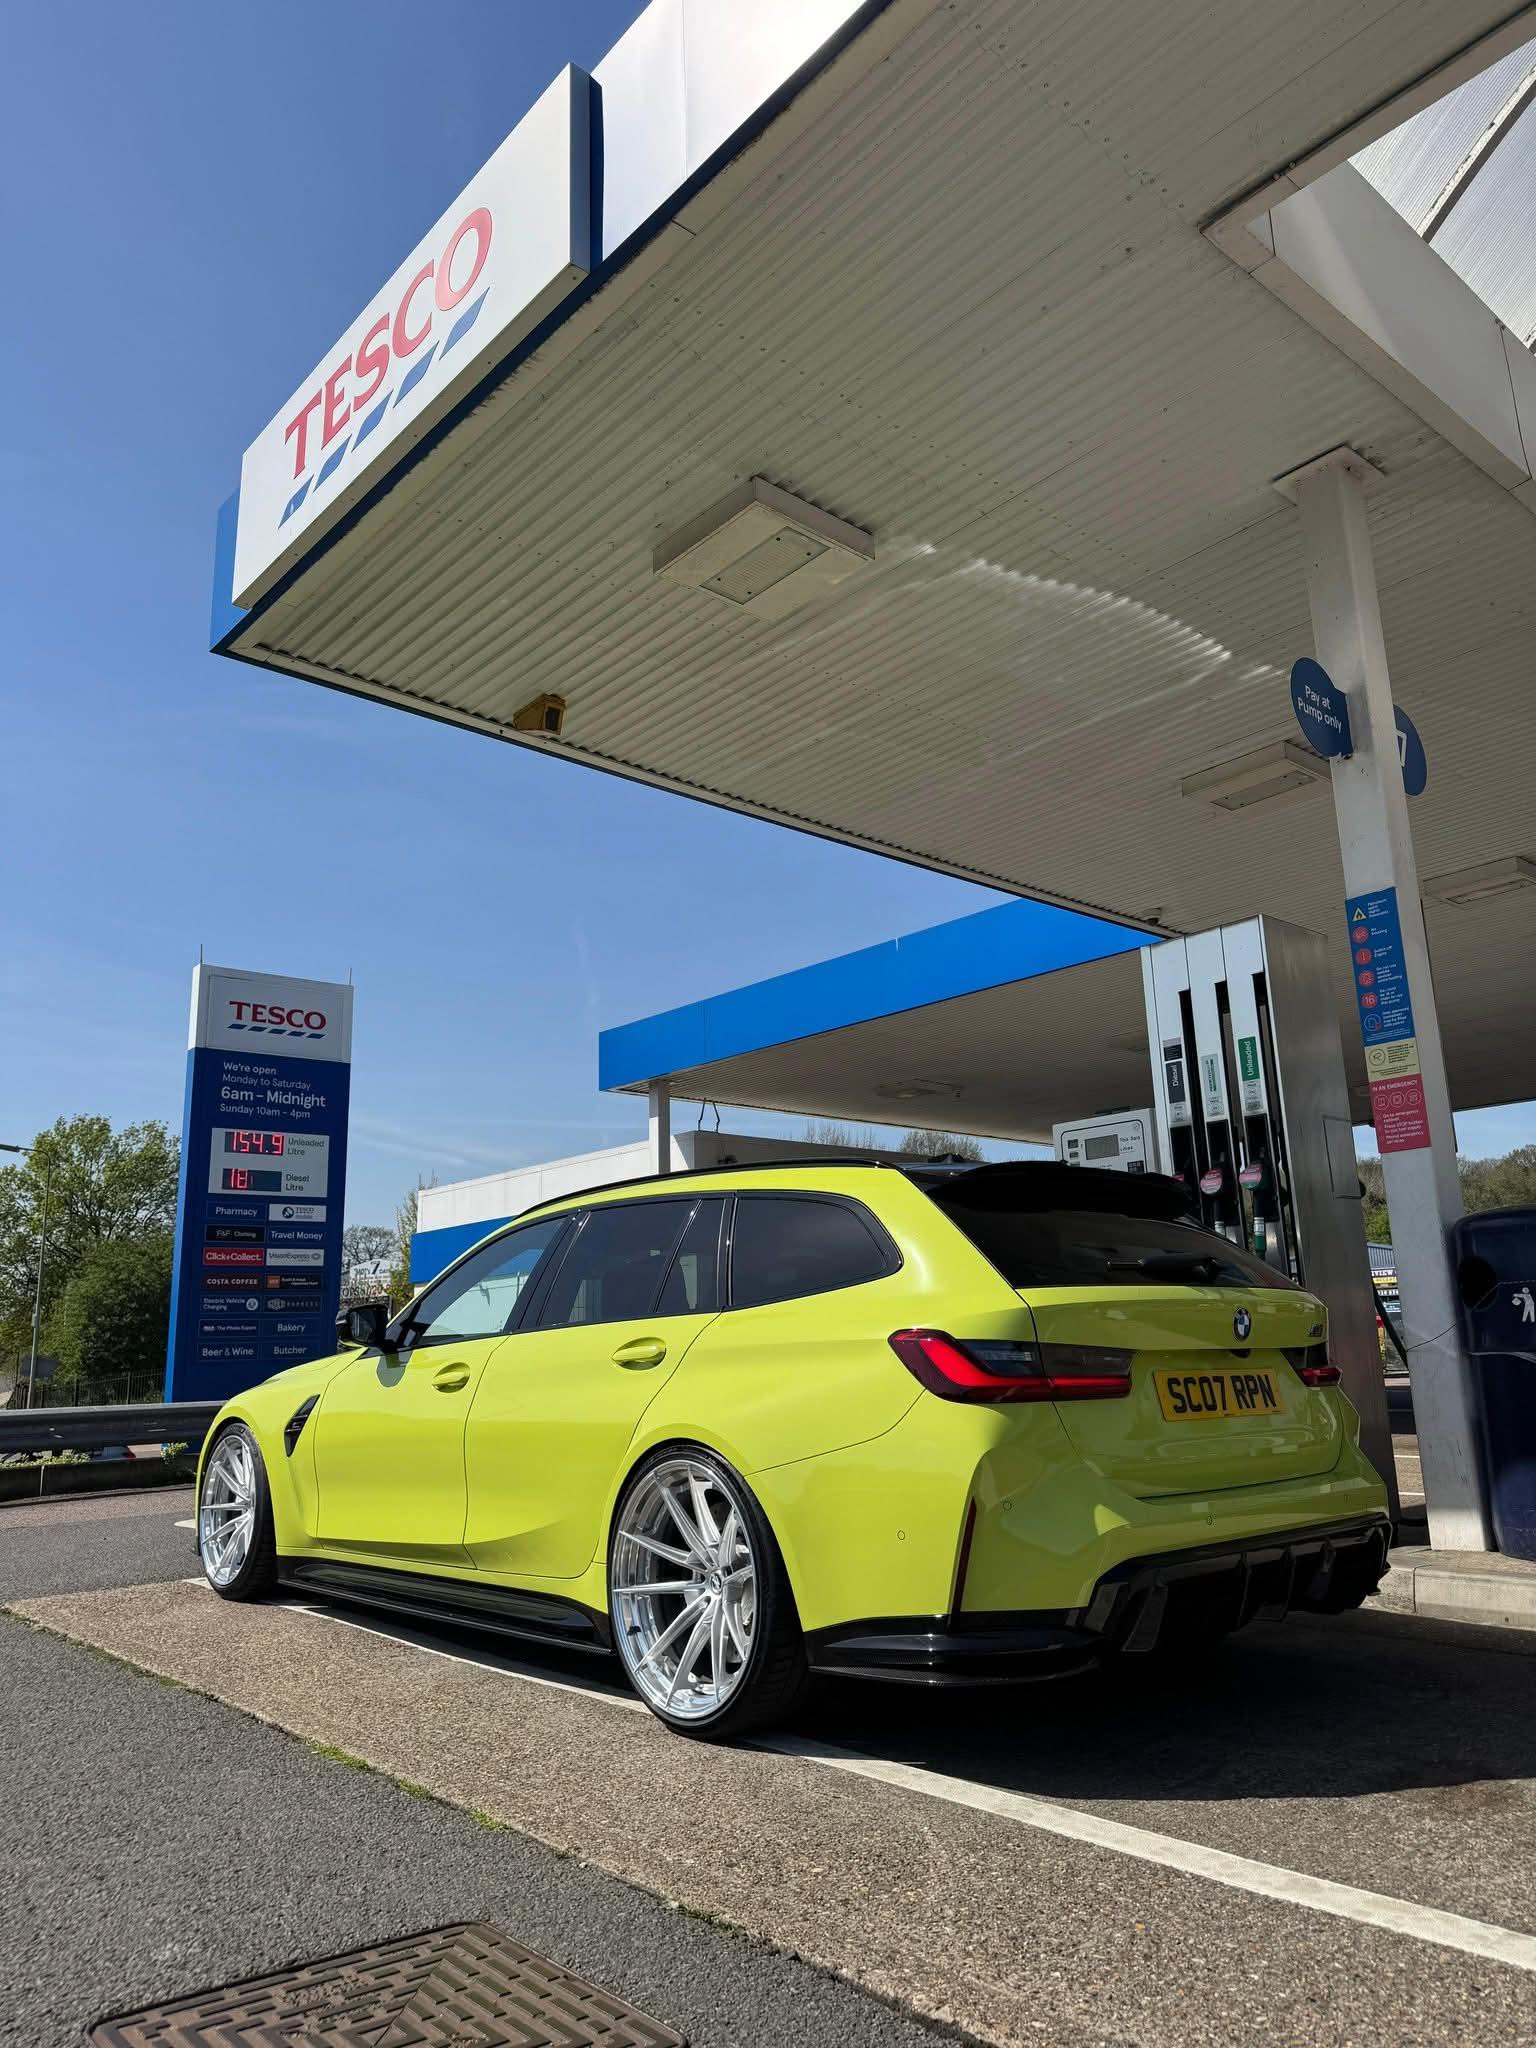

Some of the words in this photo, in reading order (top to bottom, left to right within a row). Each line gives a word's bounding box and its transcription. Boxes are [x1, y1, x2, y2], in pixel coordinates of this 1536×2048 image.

[284, 206, 493, 480] TESCO
[1305, 685, 1320, 706] Pay
[1321, 697, 1331, 710] at
[1297, 696, 1323, 723] Pump
[1324, 714, 1342, 734] only
[229, 1000, 327, 1030] TESCO
[1243, 1040, 1254, 1076] Unleaded
[223, 1061, 251, 1073] We're
[252, 1065, 277, 1076] open
[1171, 1064, 1179, 1087] Diesel
[222, 1073, 258, 1087] Monday
[260, 1077, 271, 1087] to
[272, 1078, 311, 1091] Saturday
[221, 1086, 254, 1101] 6am
[266, 1090, 326, 1109] Midnight
[220, 1103, 254, 1117] Sunday
[256, 1106, 281, 1117] 10am
[290, 1109, 311, 1120] 4pm
[232, 1131, 283, 1154] 154.9
[288, 1137, 325, 1148] Unleaded
[287, 1147, 306, 1156] Litre
[286, 1173, 310, 1182] Diesel
[285, 1183, 304, 1192] Litre
[215, 1206, 258, 1217] Pharmacy
[271, 1231, 295, 1239] Travel
[296, 1232, 323, 1241] Money
[277, 1323, 306, 1333] Bakery
[202, 1347, 223, 1357] Beer
[224, 1348, 231, 1356] &
[231, 1347, 254, 1356] Wine
[273, 1346, 307, 1355] Butcher
[1167, 1375, 1227, 1414] SC07
[1230, 1374, 1277, 1410] RPN
